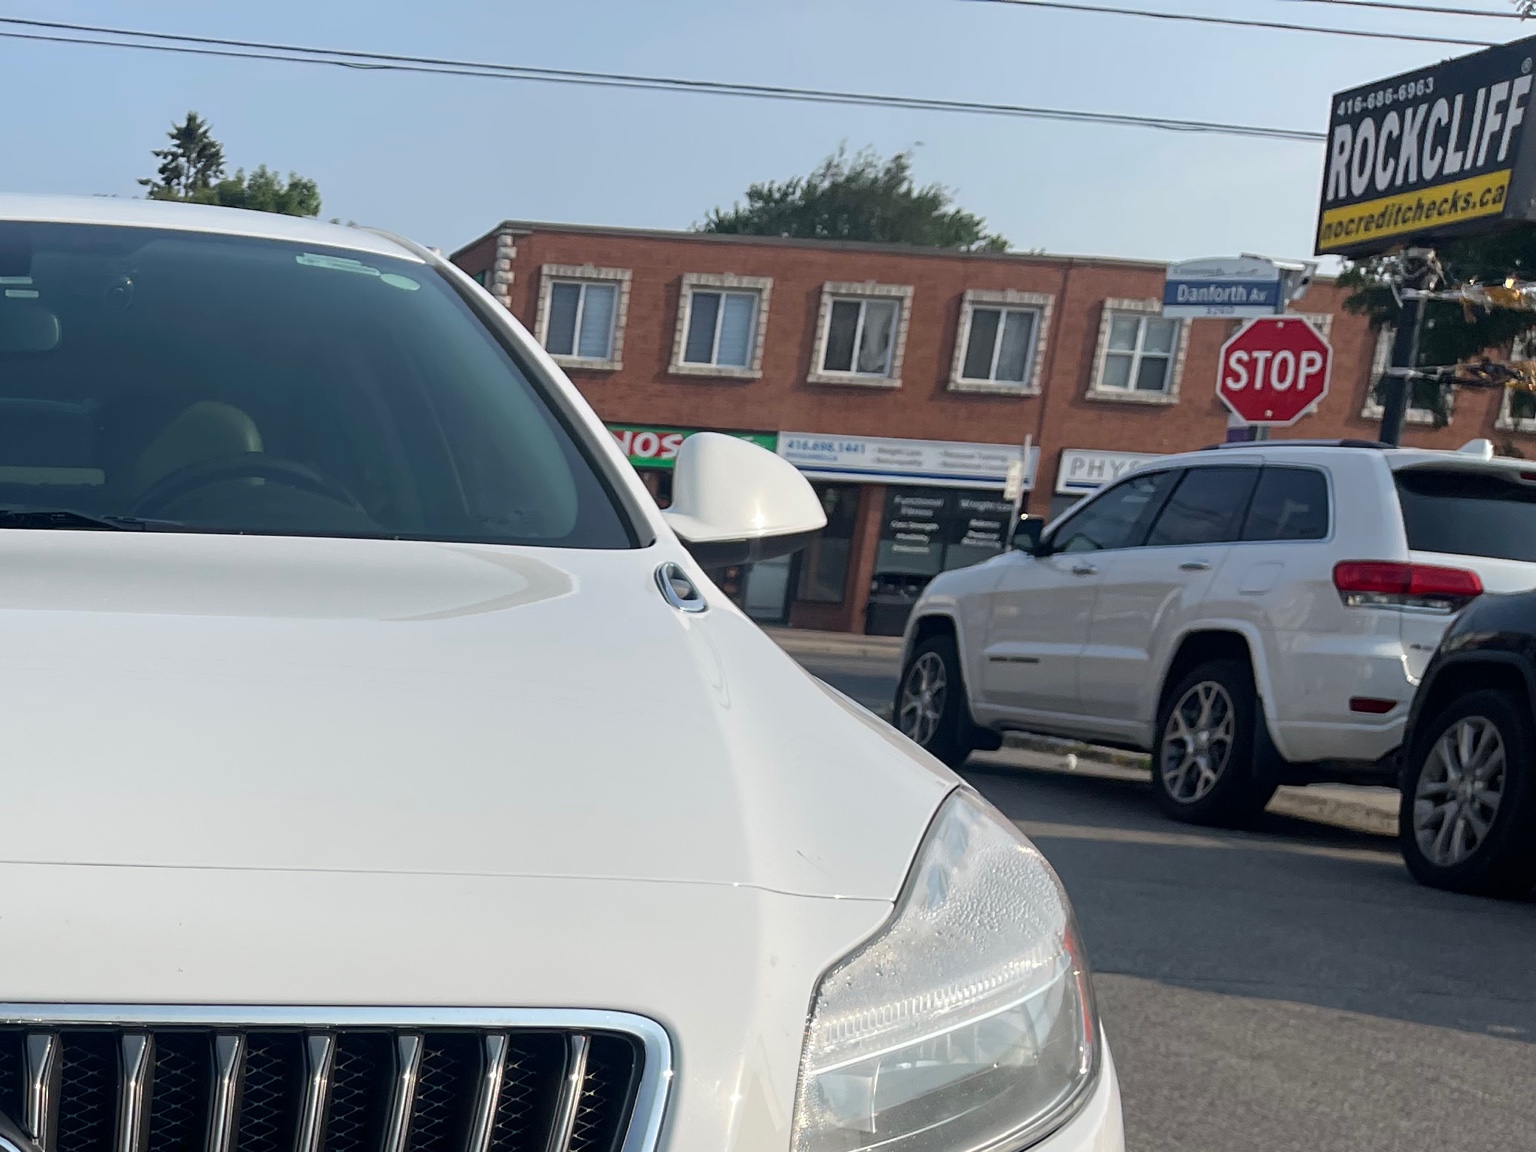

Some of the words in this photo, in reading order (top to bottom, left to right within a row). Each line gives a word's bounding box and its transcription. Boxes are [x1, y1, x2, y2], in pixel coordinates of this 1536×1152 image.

[1337, 77, 1434, 116] 416-686-6963
[1327, 74, 1533, 200] ROCKCLIFF
[1321, 184, 1506, 240] nocreditchecks.ca
[1177, 284, 1247, 302] Danforth
[1226, 350, 1323, 391] STOP
